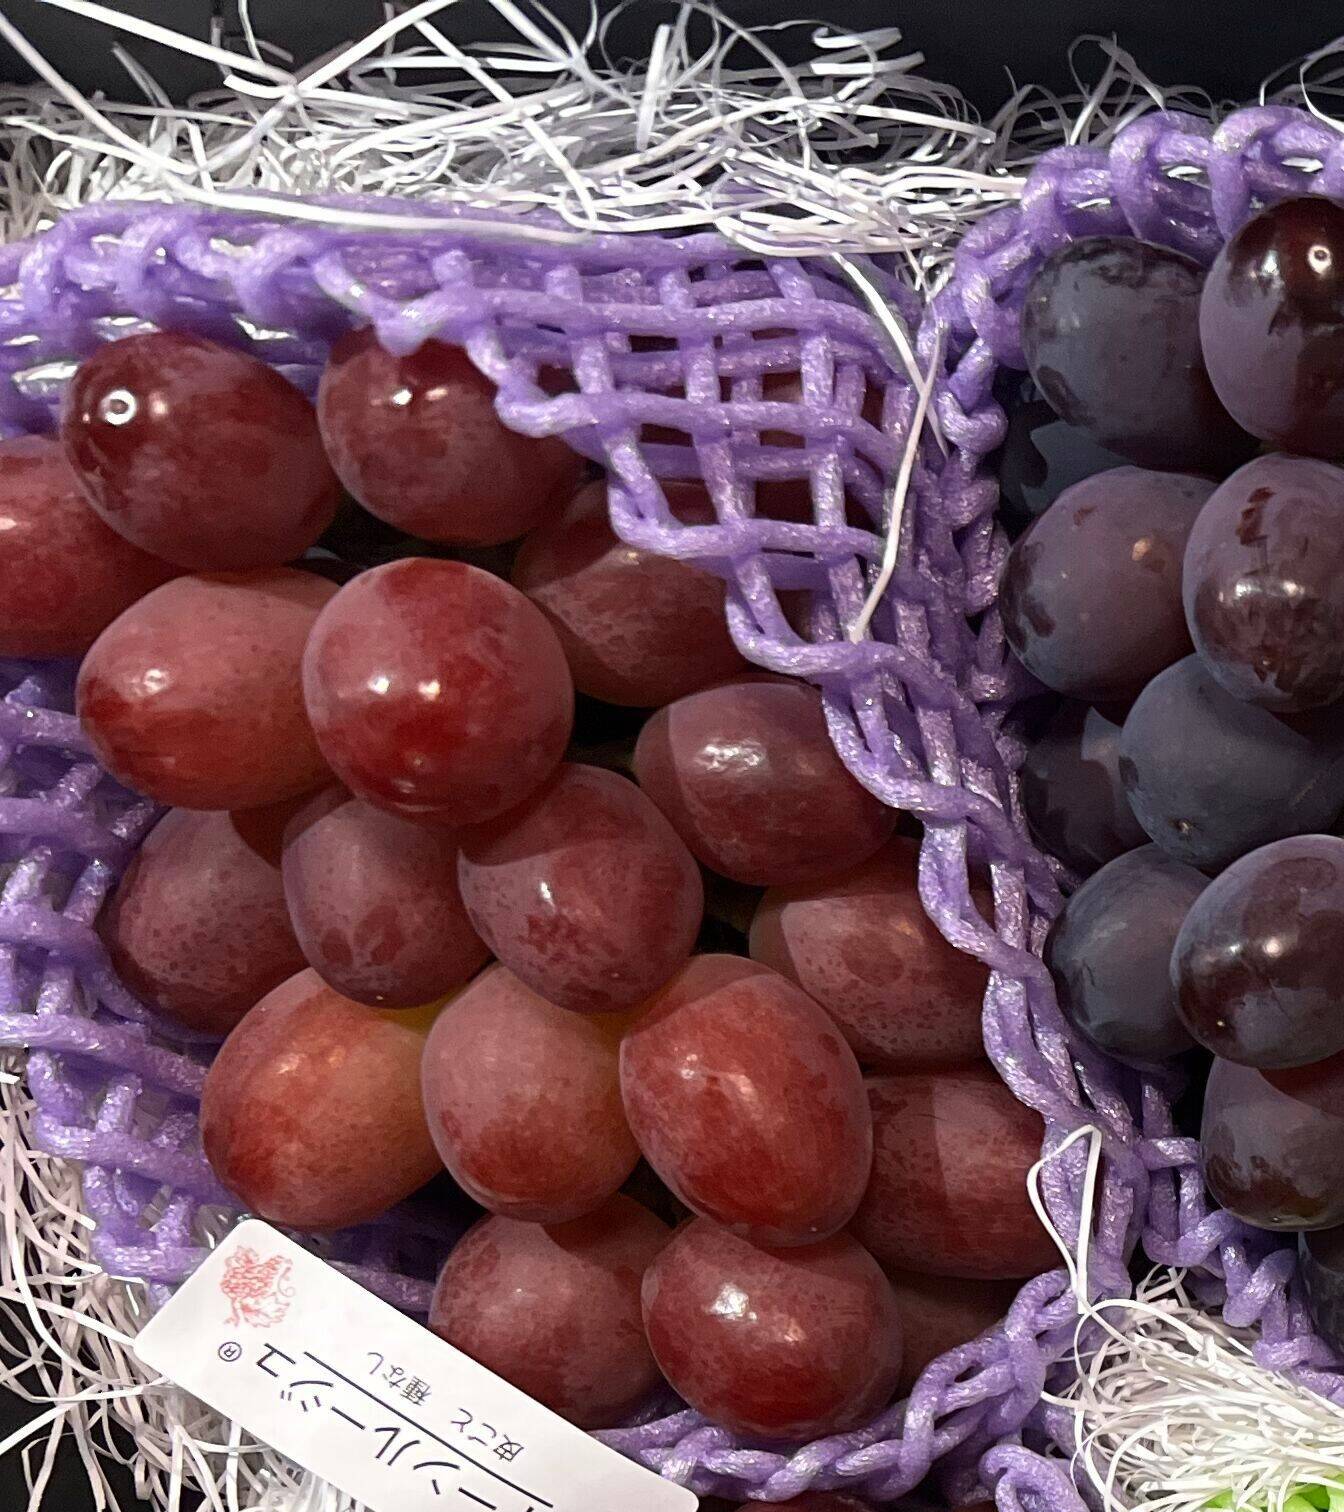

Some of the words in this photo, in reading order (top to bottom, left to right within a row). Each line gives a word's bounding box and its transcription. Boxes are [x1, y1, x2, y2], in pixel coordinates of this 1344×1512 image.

[367, 1352, 433, 1406] 種なし
[451, 1407, 525, 1462] 皮ごと
